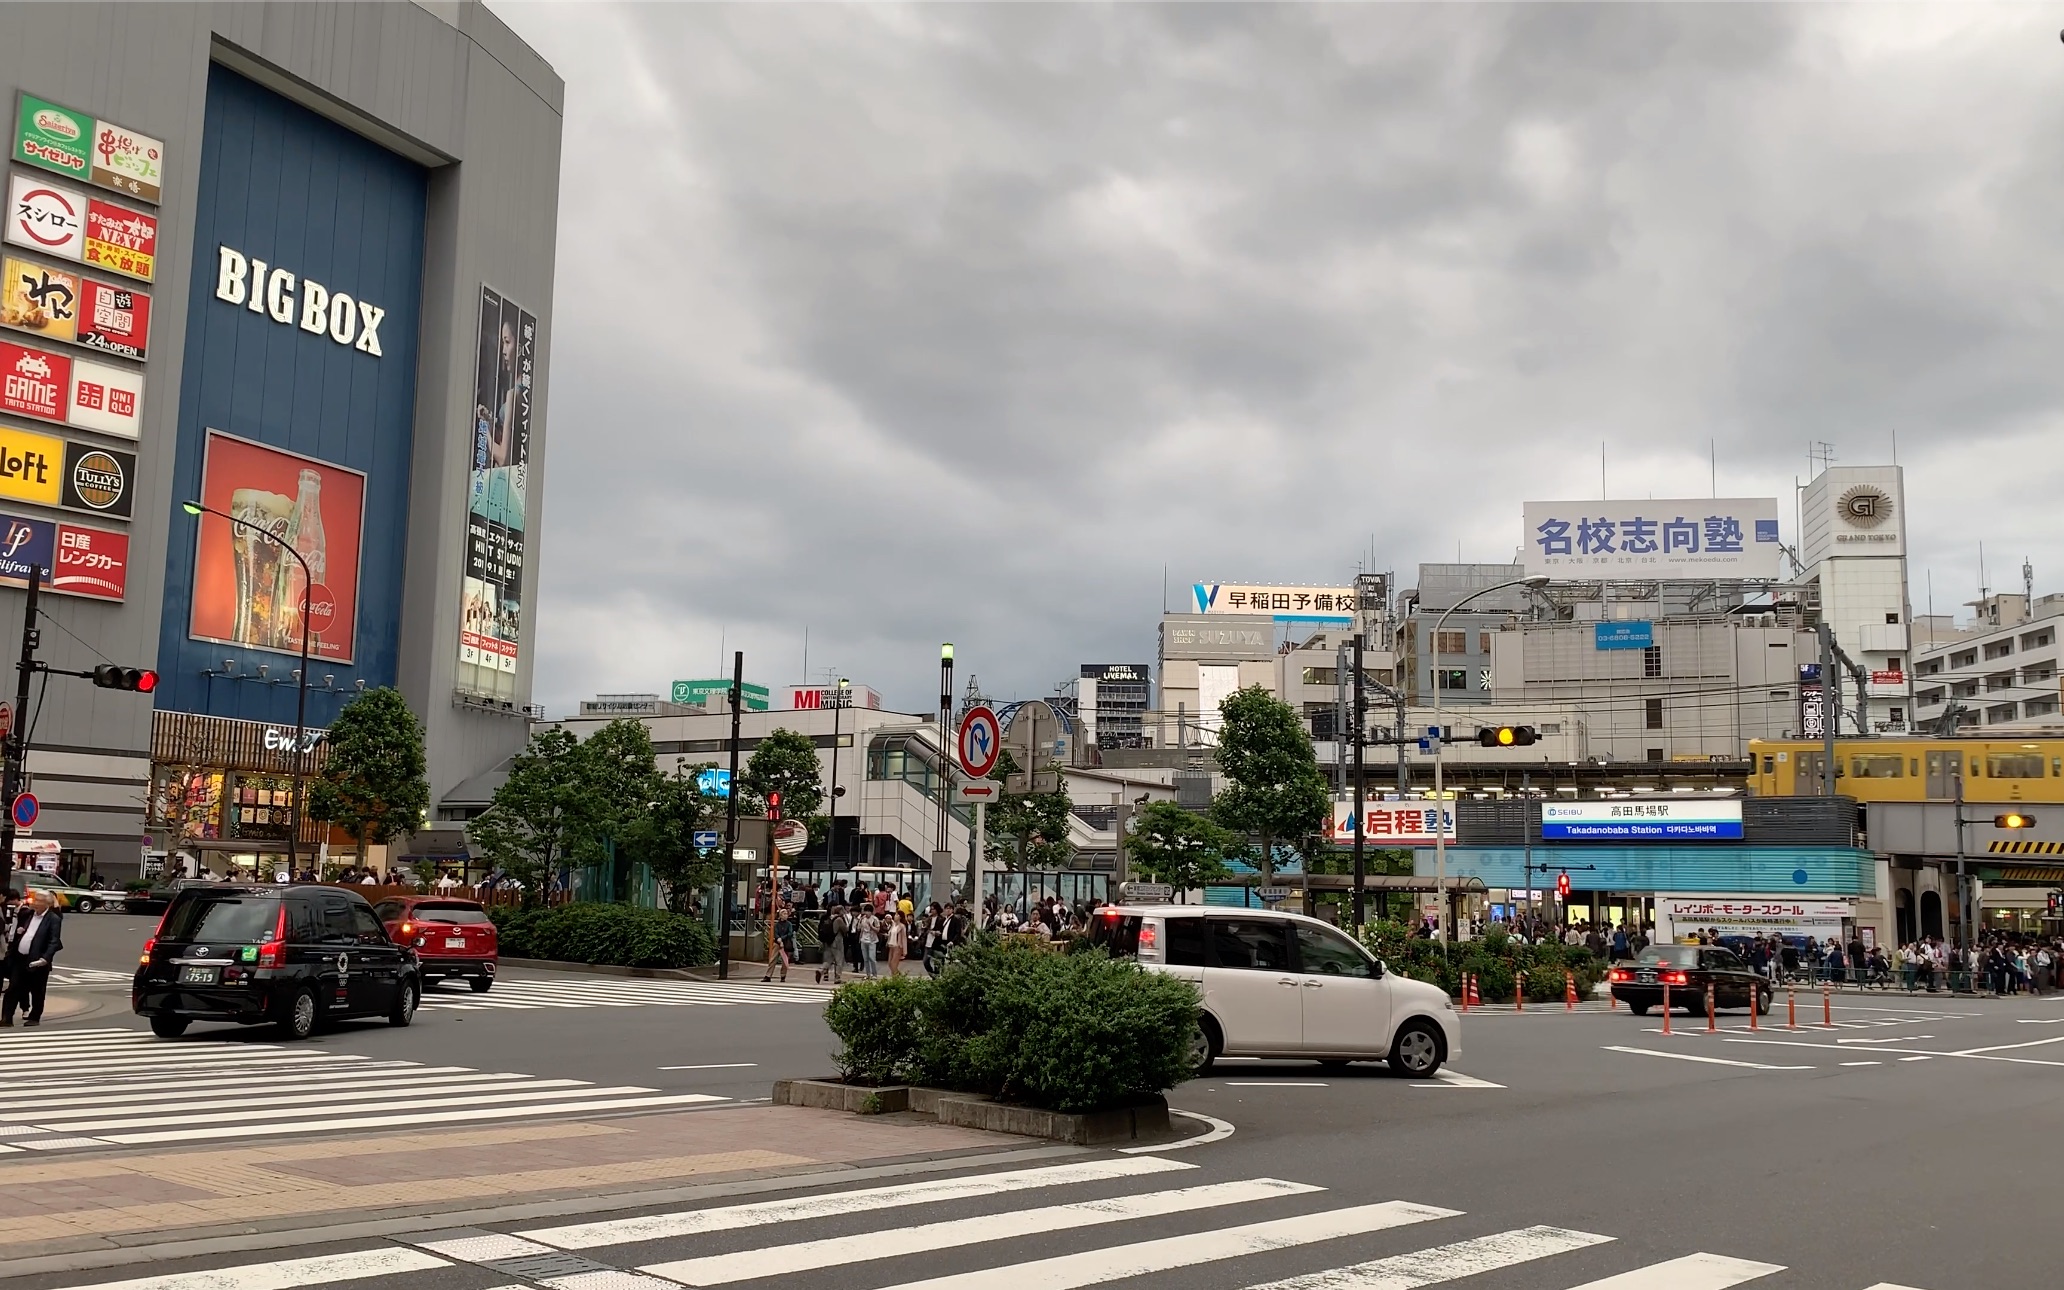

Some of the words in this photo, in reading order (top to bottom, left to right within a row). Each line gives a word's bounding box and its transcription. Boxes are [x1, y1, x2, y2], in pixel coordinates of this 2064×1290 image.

[24, 140, 84, 168] サイゼリヤ
[17, 204, 78, 228] スシロー
[89, 212, 154, 240] すたみな太郎
[98, 227, 144, 251] NEXT
[87, 248, 149, 277] 食べ放題
[216, 245, 295, 325] BIG
[300, 278, 385, 357] BOX
[5, 374, 57, 407] GAME
[112, 391, 131, 404] UNI
[5, 397, 24, 409] TAITO
[26, 401, 55, 415] STATION
[111, 401, 131, 413] QLO
[84, 481, 112, 492] COFFEE
[1848, 495, 1879, 517] GT
[61, 531, 91, 550] 日産
[1536, 516, 1744, 555] 名校志向塾
[1868, 534, 1896, 542] TOKYO
[59, 549, 123, 570] レンタカー
[496, 548, 522, 568] STUDIO
[0, 559, 49, 576] lifrae
[1228, 591, 1355, 612] 早稲田予備校
[1199, 629, 1265, 646] SUZUYA
[1103, 672, 1138, 680] LIVEMAX
[795, 690, 820, 708] MI
[820, 699, 852, 708] MUSIC
[1610, 805, 1669, 817] 高田馬場駅
[1566, 825, 1629, 834] Takadanobaba
[1631, 826, 1662, 834] Station
[1674, 903, 1804, 916] レインボーモータースクール
